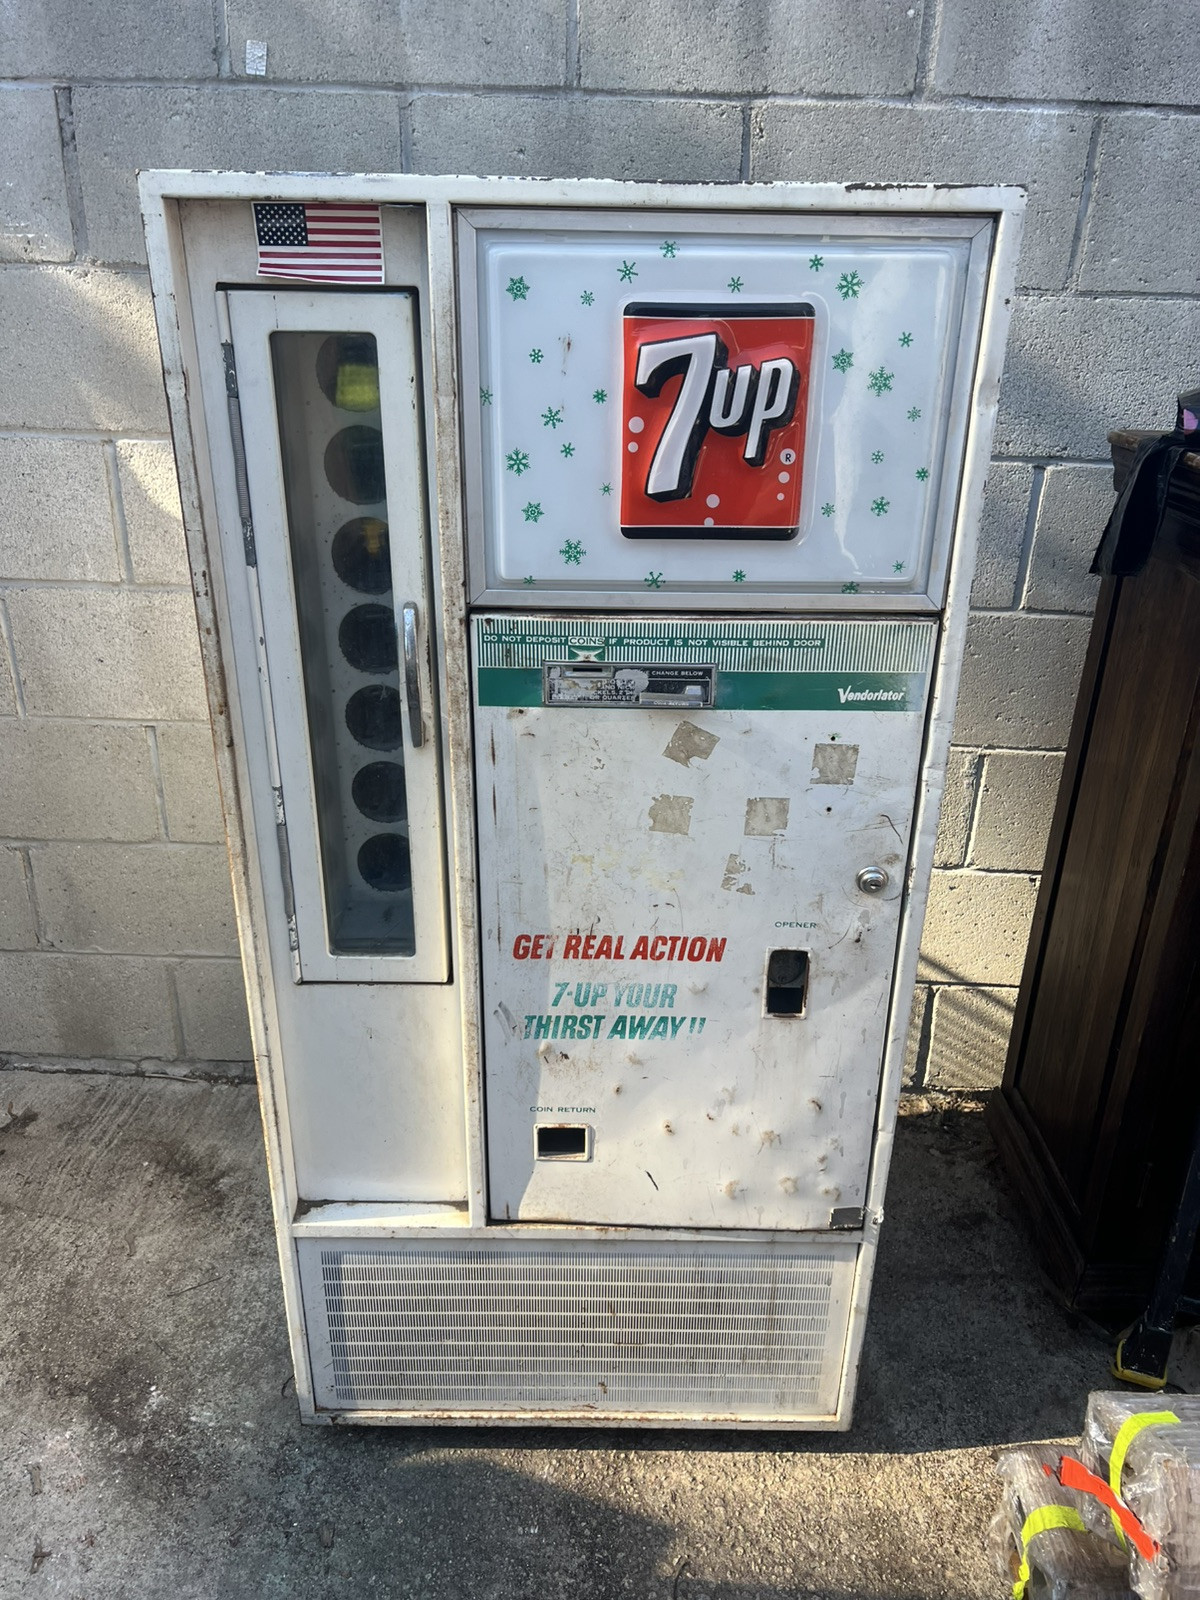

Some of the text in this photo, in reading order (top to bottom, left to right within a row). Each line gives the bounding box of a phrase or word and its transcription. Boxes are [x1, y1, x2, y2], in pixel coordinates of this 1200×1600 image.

[483, 634, 822, 648] DO NOT DEPOSIT COINS IF PRODUCT IS NOT VISIBLE BEHIND DOOR
[837, 685, 905, 704] Vendorlator
[774, 920, 818, 929] OPENER
[512, 934, 728, 962] GET REAL ACTION
[551, 981, 678, 1008] 7-UP YOUR
[522, 1014, 605, 1039] THIRST
[529, 1105, 597, 1114] COIN RETURN
